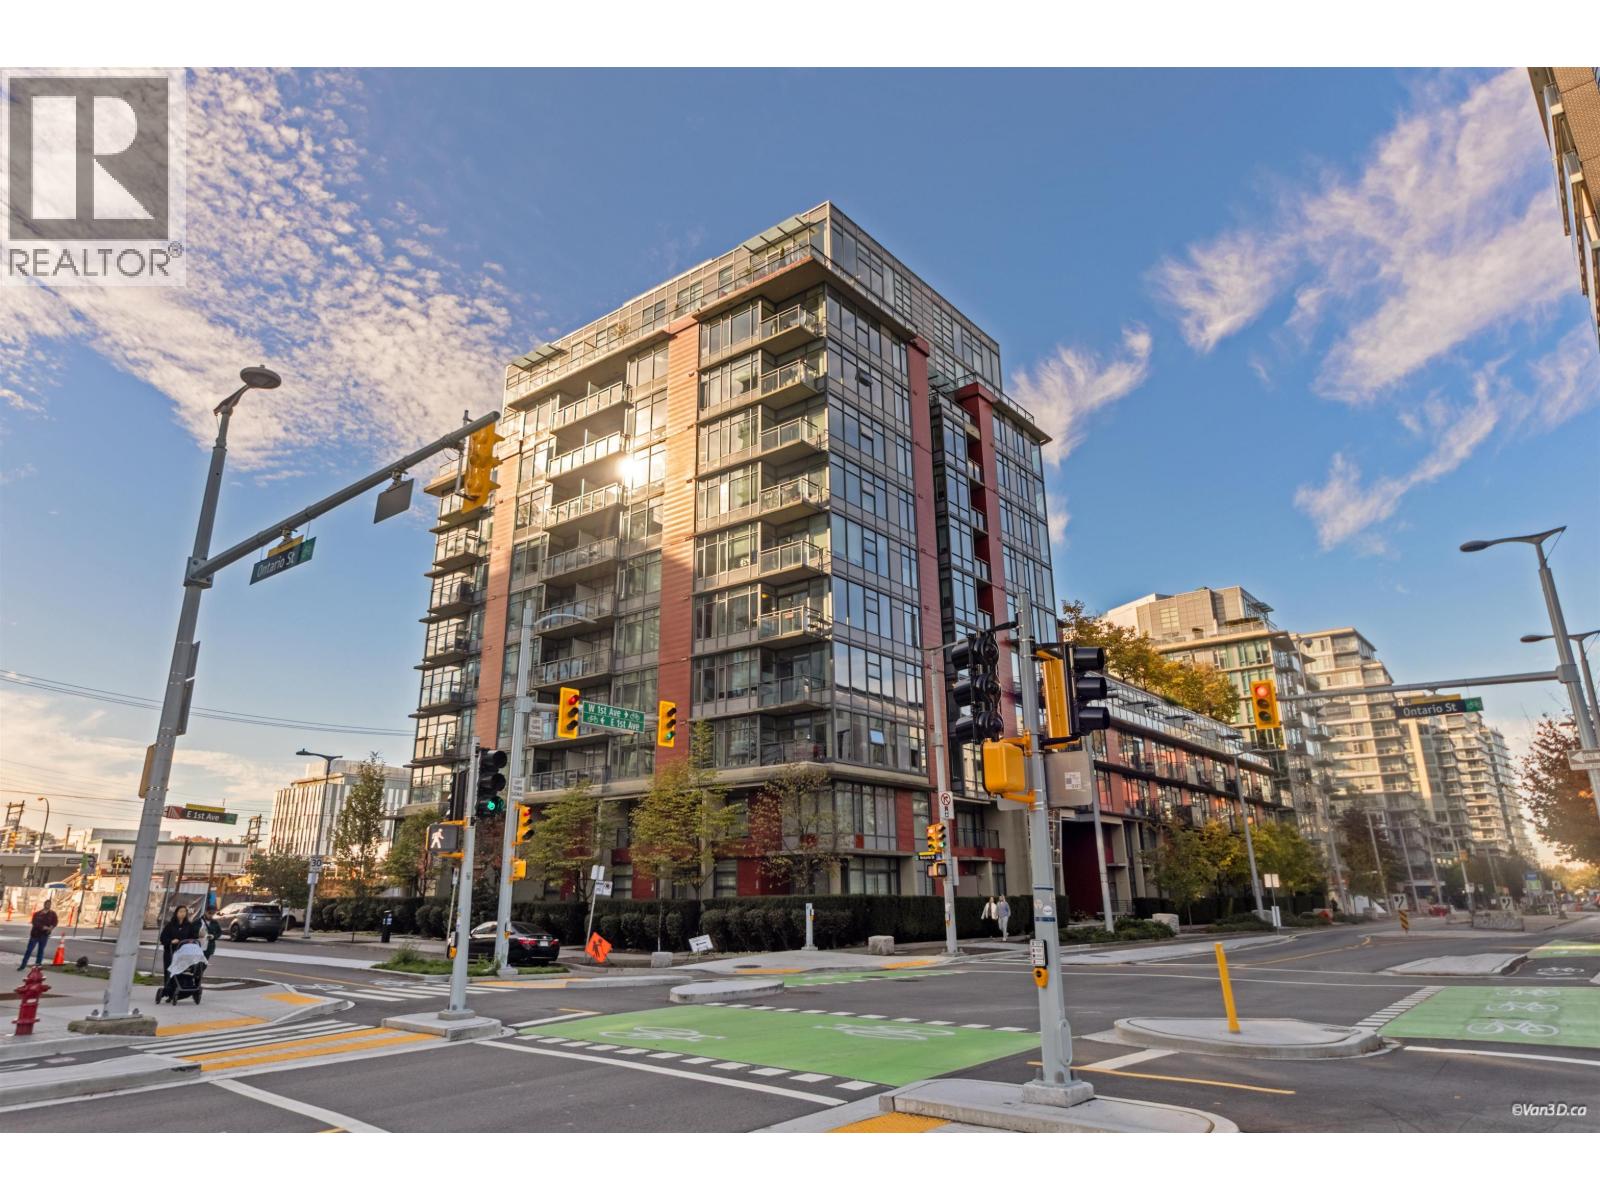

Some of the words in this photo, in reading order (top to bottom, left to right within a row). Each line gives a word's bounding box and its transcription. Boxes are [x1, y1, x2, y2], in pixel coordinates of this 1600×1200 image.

[257, 556, 285, 577] Ontario
[286, 552, 295, 566] St
[589, 703, 596, 713] W
[597, 705, 607, 716] 1st
[609, 707, 621, 718] Ave
[1403, 704, 1443, 717] Ontario
[1445, 702, 1457, 712] St
[611, 718, 615, 727] E
[617, 719, 626, 729] 1st
[628, 721, 640, 731] Ave
[186, 810, 193, 818] E
[194, 811, 205, 820] 1st
[206, 813, 220, 821] Ave
[311, 859, 322, 867] 30
